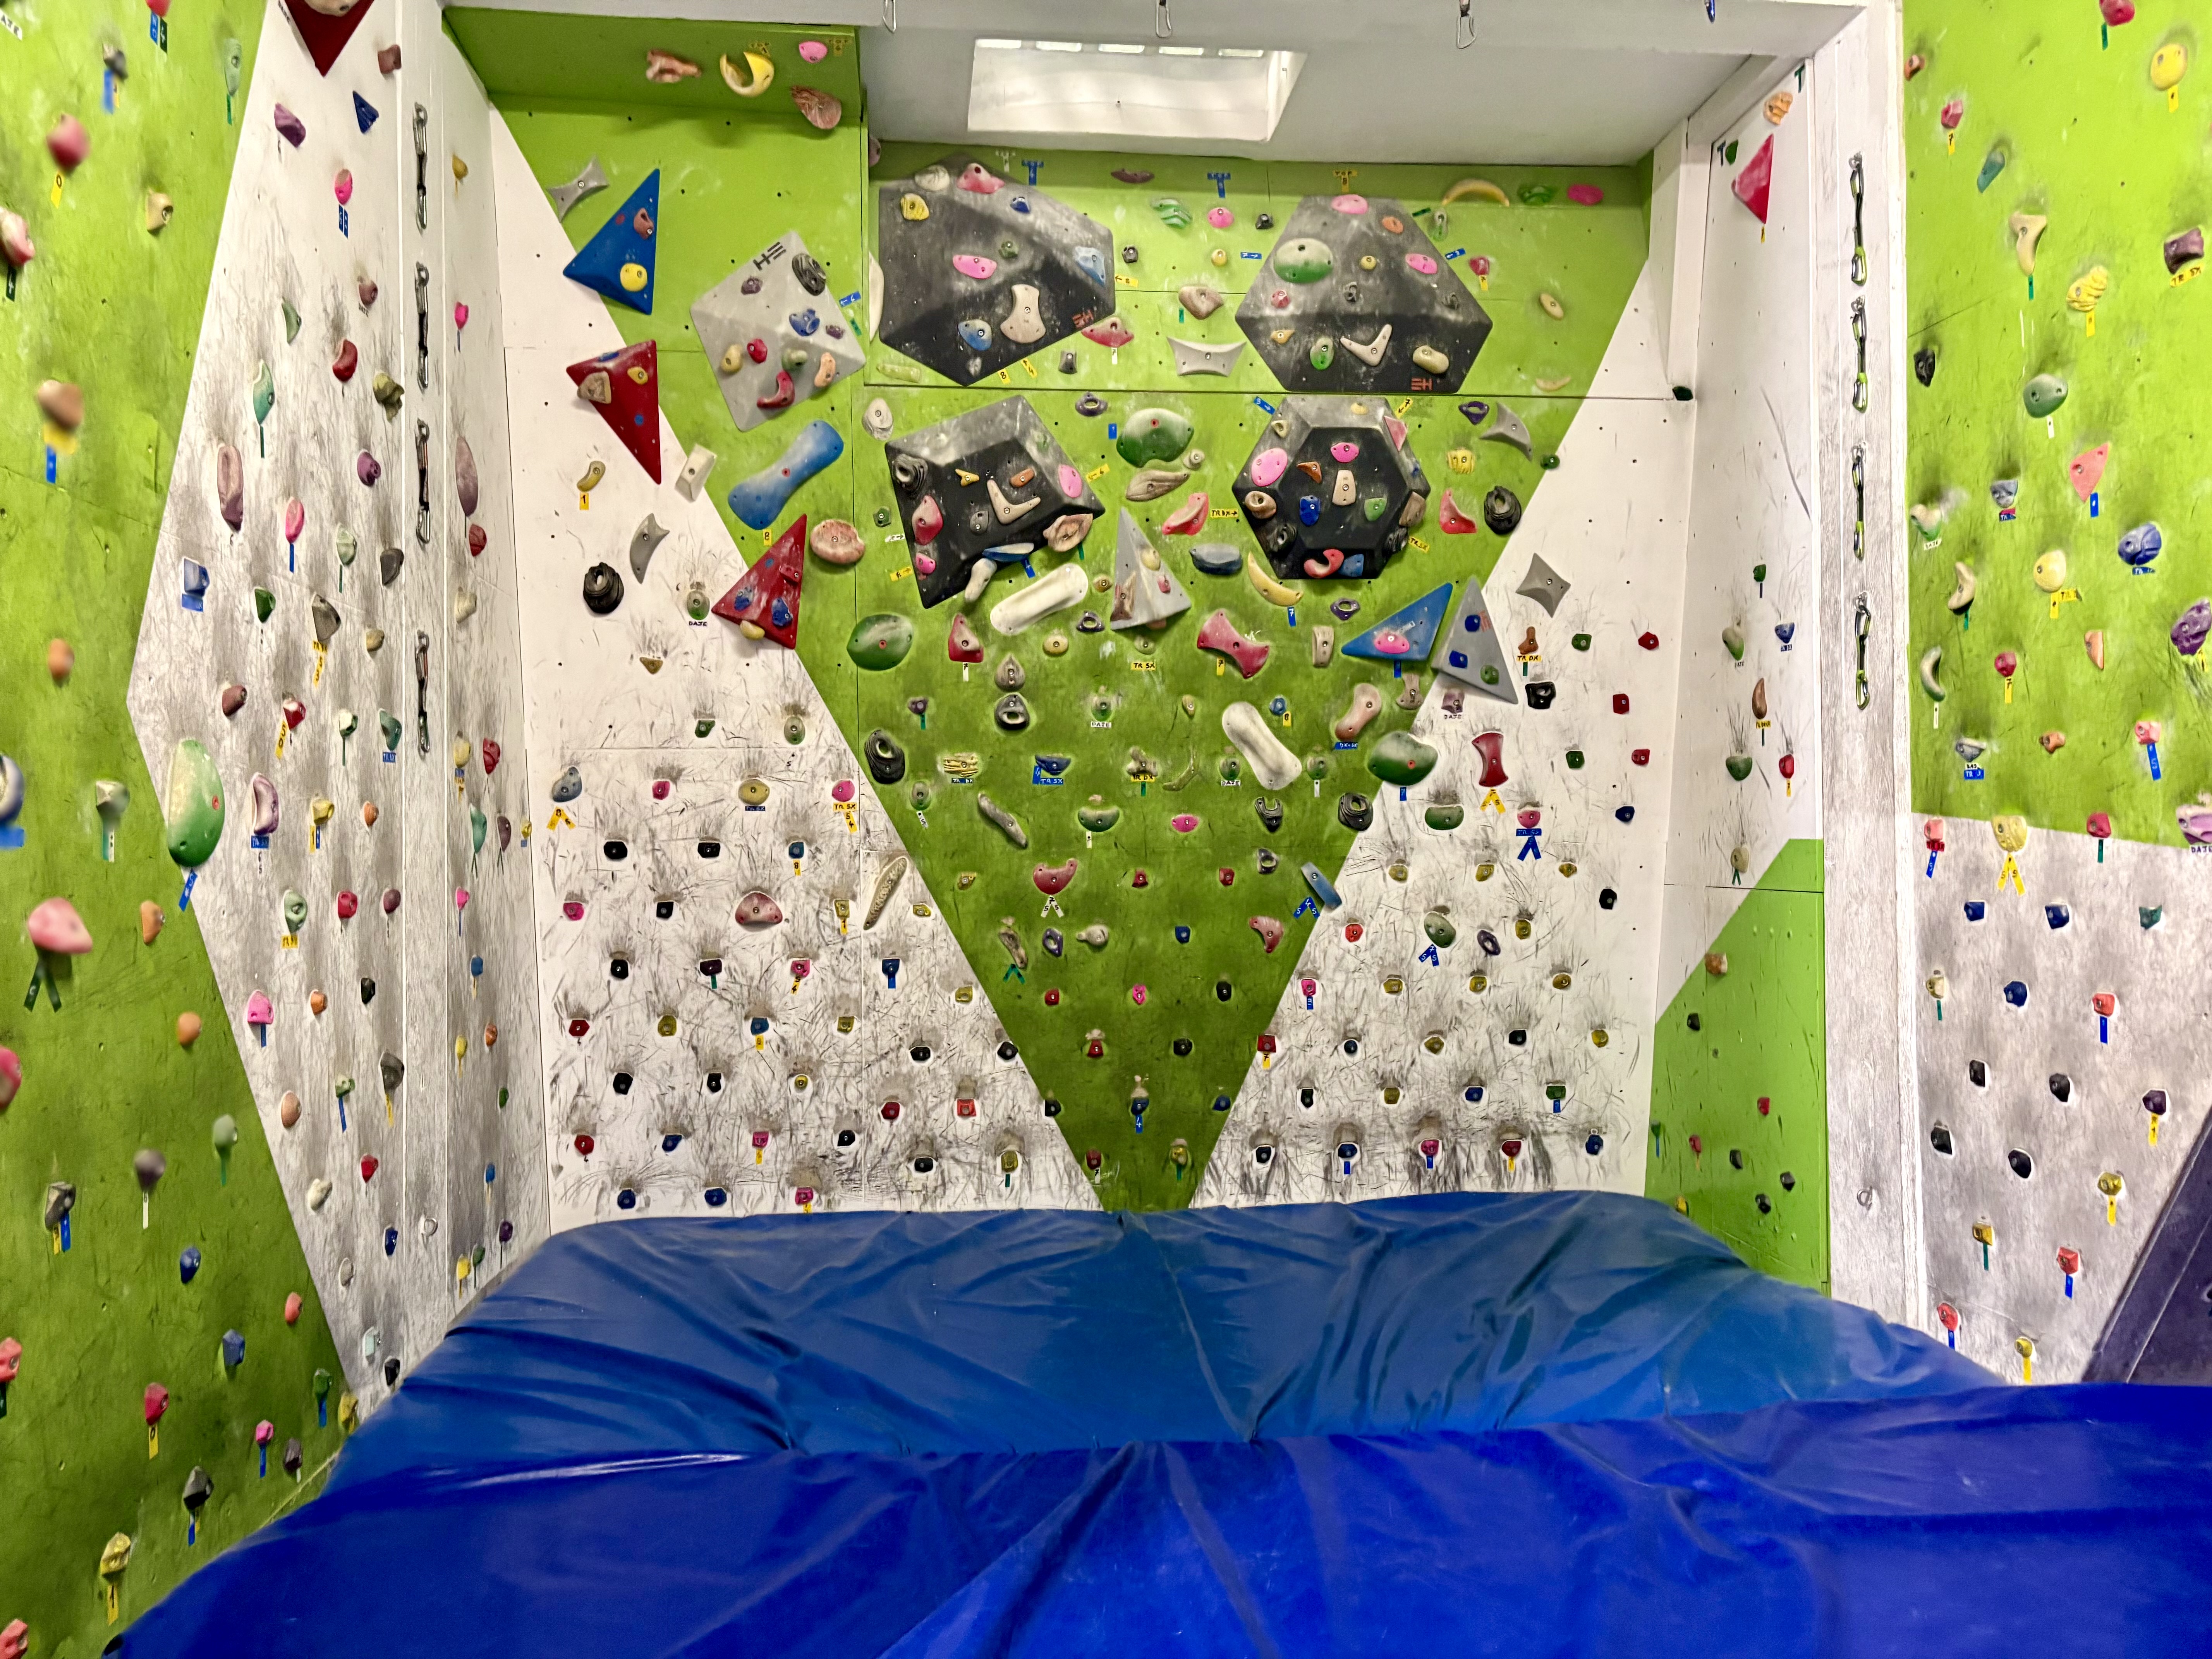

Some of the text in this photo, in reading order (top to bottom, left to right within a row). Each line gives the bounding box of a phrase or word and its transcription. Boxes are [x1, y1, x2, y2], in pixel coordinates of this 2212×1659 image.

[1949, 133, 1953, 146] 7
[1000, 371, 1007, 380] 8
[764, 532, 769, 540] 8
[1288, 608, 1294, 617] 7
[2007, 678, 2012, 690] 7
[1305, 898, 1311, 908] 4
[792, 985, 797, 994] 4
[1136, 1117, 1142, 1127] 4
